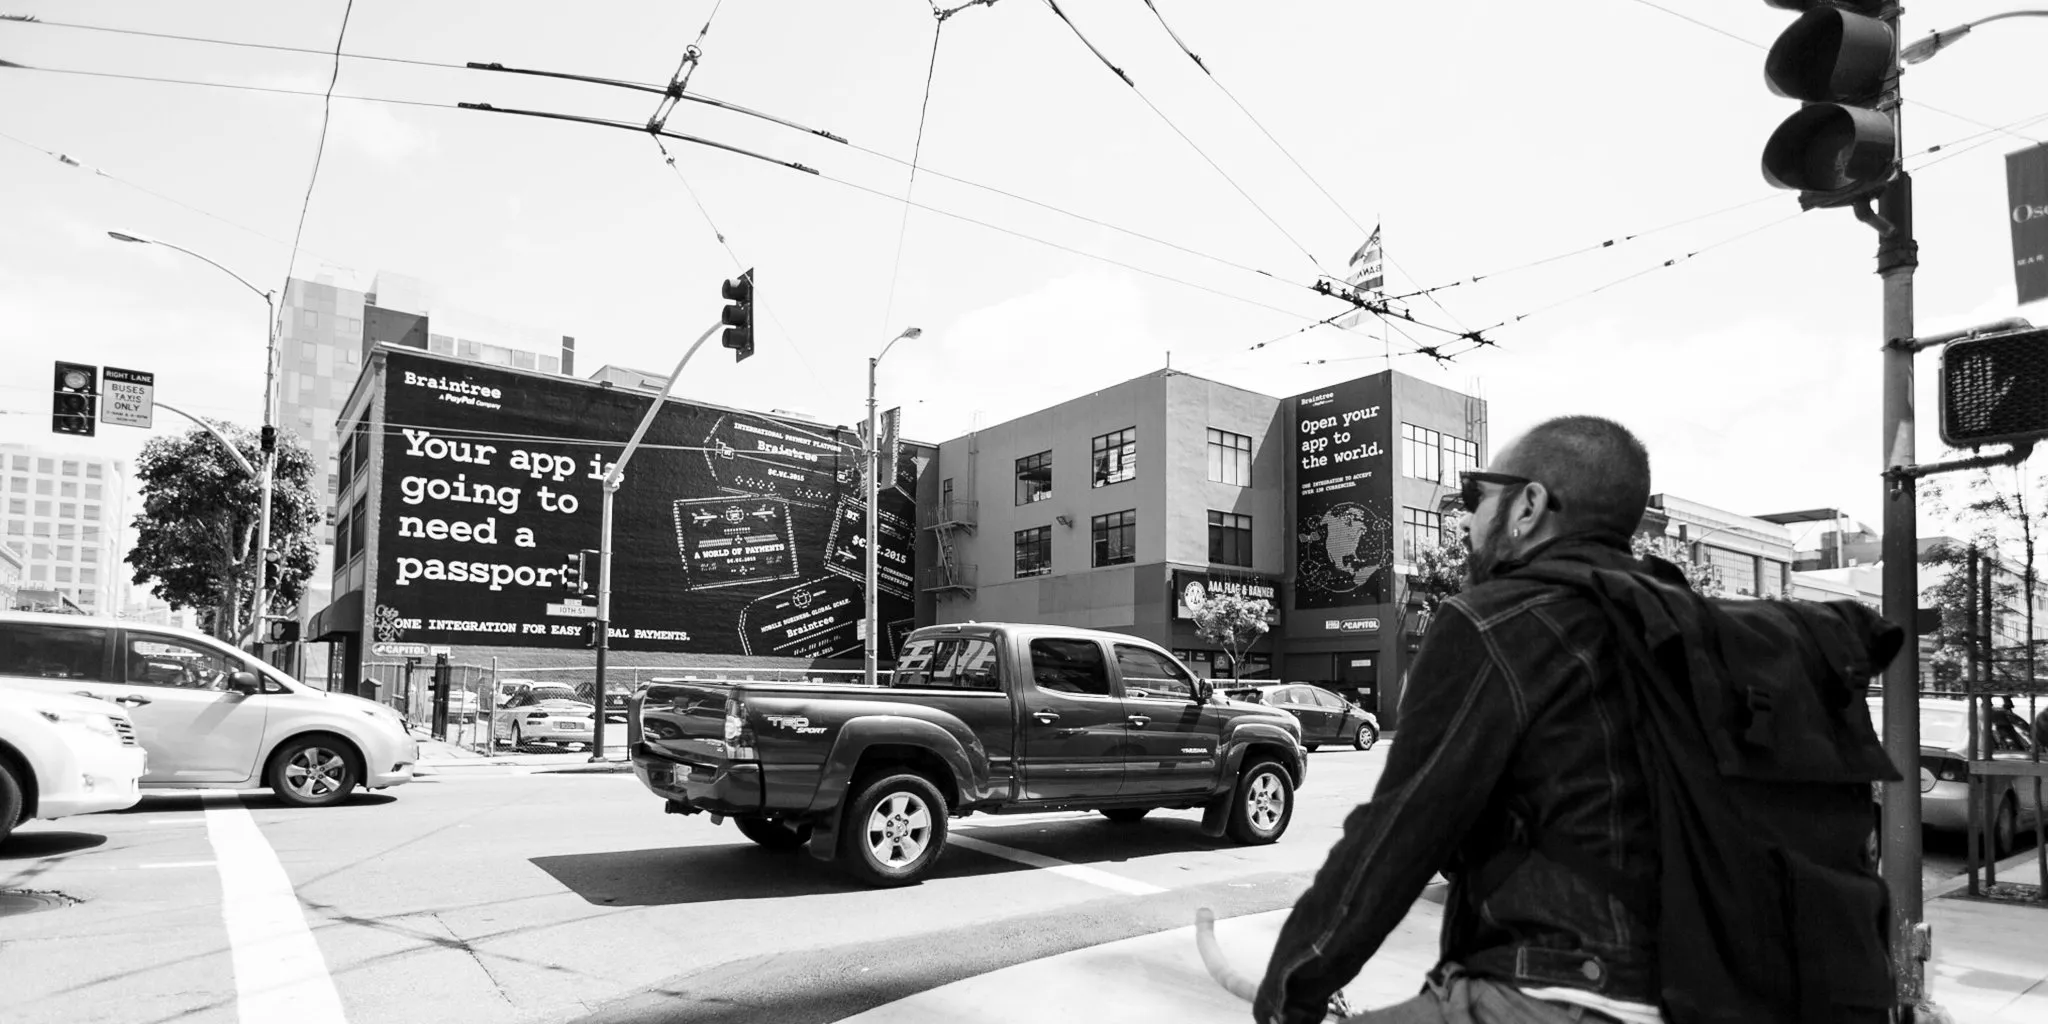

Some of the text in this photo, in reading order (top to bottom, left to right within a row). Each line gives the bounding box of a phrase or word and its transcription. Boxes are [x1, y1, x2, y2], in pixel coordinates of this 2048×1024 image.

[106, 370, 152, 383] RIGHT LANE
[404, 371, 502, 399] Braintree
[112, 383, 145, 395] BUSES
[115, 393, 142, 403] TAXIS
[1301, 392, 1334, 405] Braintree
[114, 402, 140, 411] ONLY
[445, 393, 475, 405] PayPal
[1301, 405, 1380, 435] Open your
[734, 422, 842, 453] INTERNATIONAL PAYMENT PLATFORM
[1301, 432, 1351, 453] app to
[402, 428, 497, 465] Your
[510, 449, 576, 482] app
[757, 440, 818, 462] Braintree
[1302, 441, 1384, 469] the world.
[401, 473, 579, 514] going to
[846, 509, 860, 521] BT
[398, 516, 536, 548] need a
[694, 543, 785, 560] A WORLD OF PAYMENTS
[1208, 580, 1223, 592] AAA
[1249, 585, 1274, 598] BANNER
[394, 618, 690, 641] ONE INTEGRATION FOR EASY BAL PAYMENTS.
[786, 616, 834, 638] Braintree
[1348, 620, 1378, 629] CAPITOL
[386, 645, 426, 654] CAPITOL
